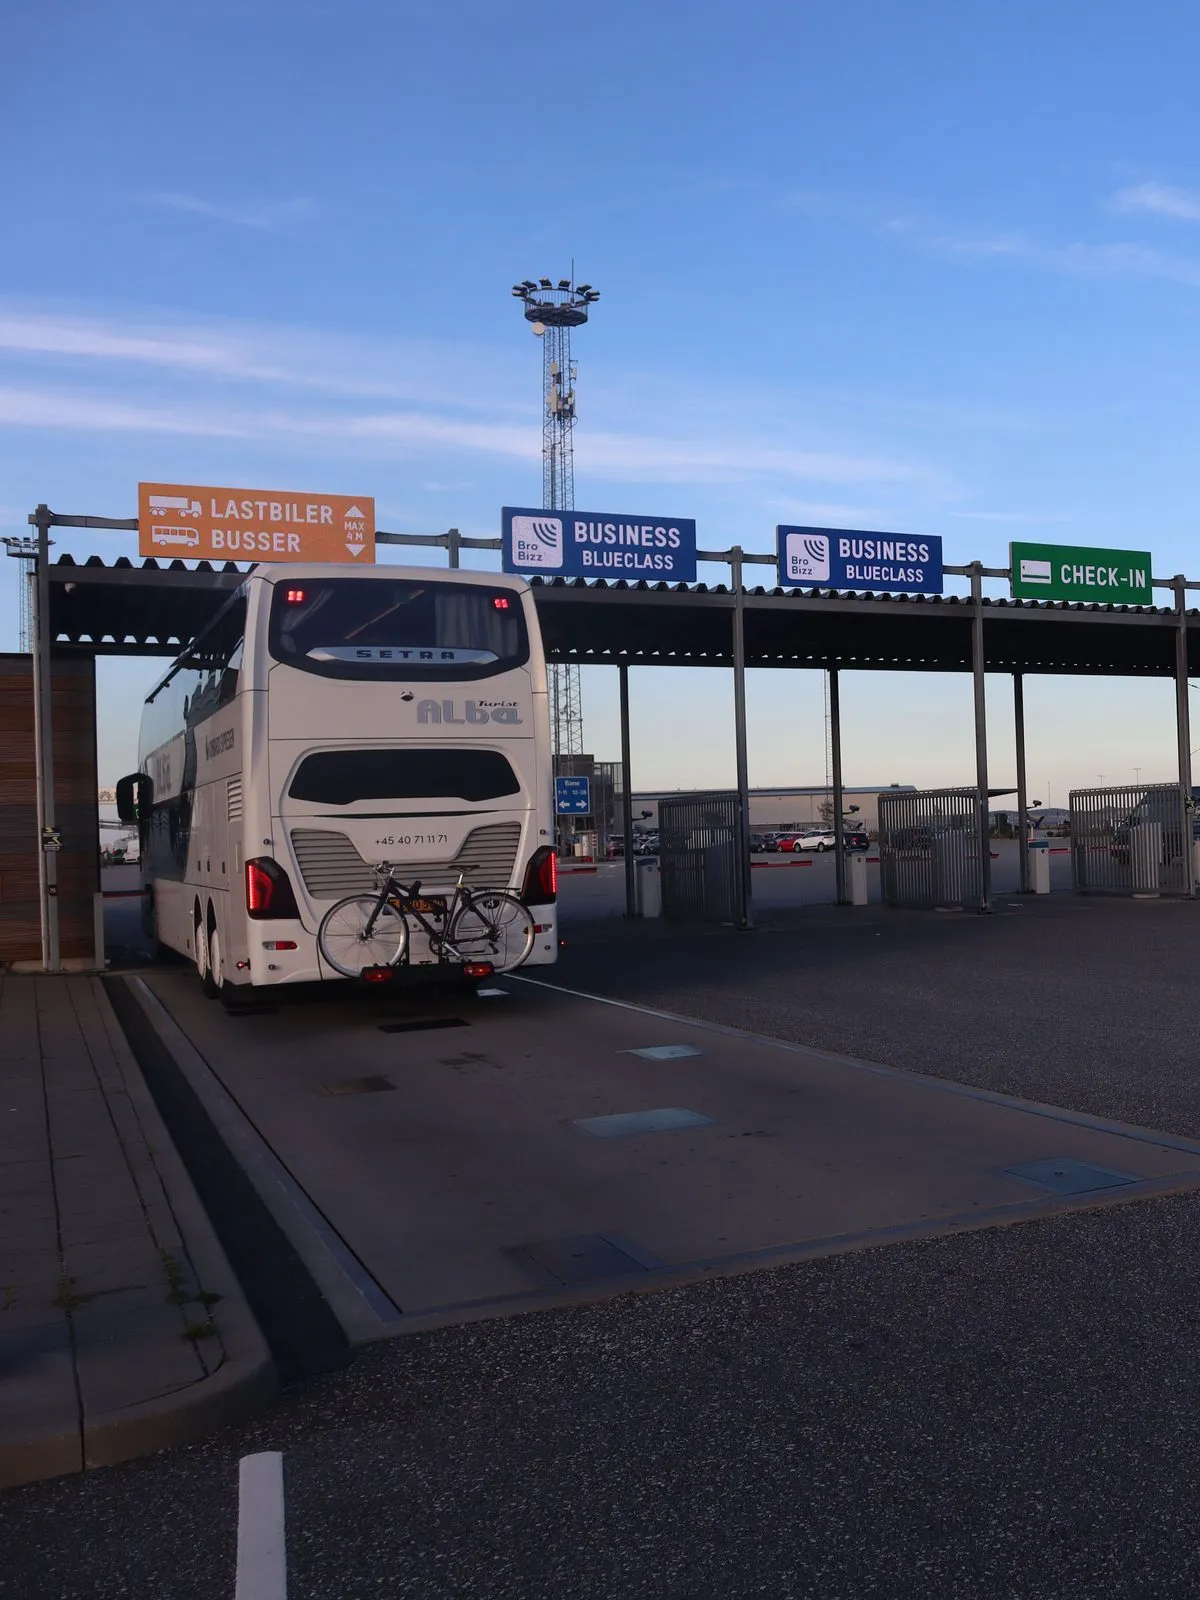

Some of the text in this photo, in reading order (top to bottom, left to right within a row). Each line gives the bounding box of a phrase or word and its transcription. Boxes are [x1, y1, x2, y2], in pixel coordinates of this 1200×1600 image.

[211, 499, 333, 524] LASTBILER
[344, 521, 365, 532] MAX
[347, 532, 363, 541] 4 M
[574, 521, 680, 548] BUSINESS
[211, 529, 300, 553] BUSSER
[518, 540, 538, 551] Bro
[839, 538, 930, 563] BUSINESS
[518, 552, 542, 562] Bizz
[582, 550, 674, 570] BLUECLASS
[791, 556, 809, 565] Bro
[791, 566, 812, 575] Bizz
[846, 565, 924, 583] BLUECLASS
[1061, 564, 1146, 588] CHECK-IN
[356, 650, 455, 660] SETRA
[375, 834, 448, 845] +45 40 71 11 71
